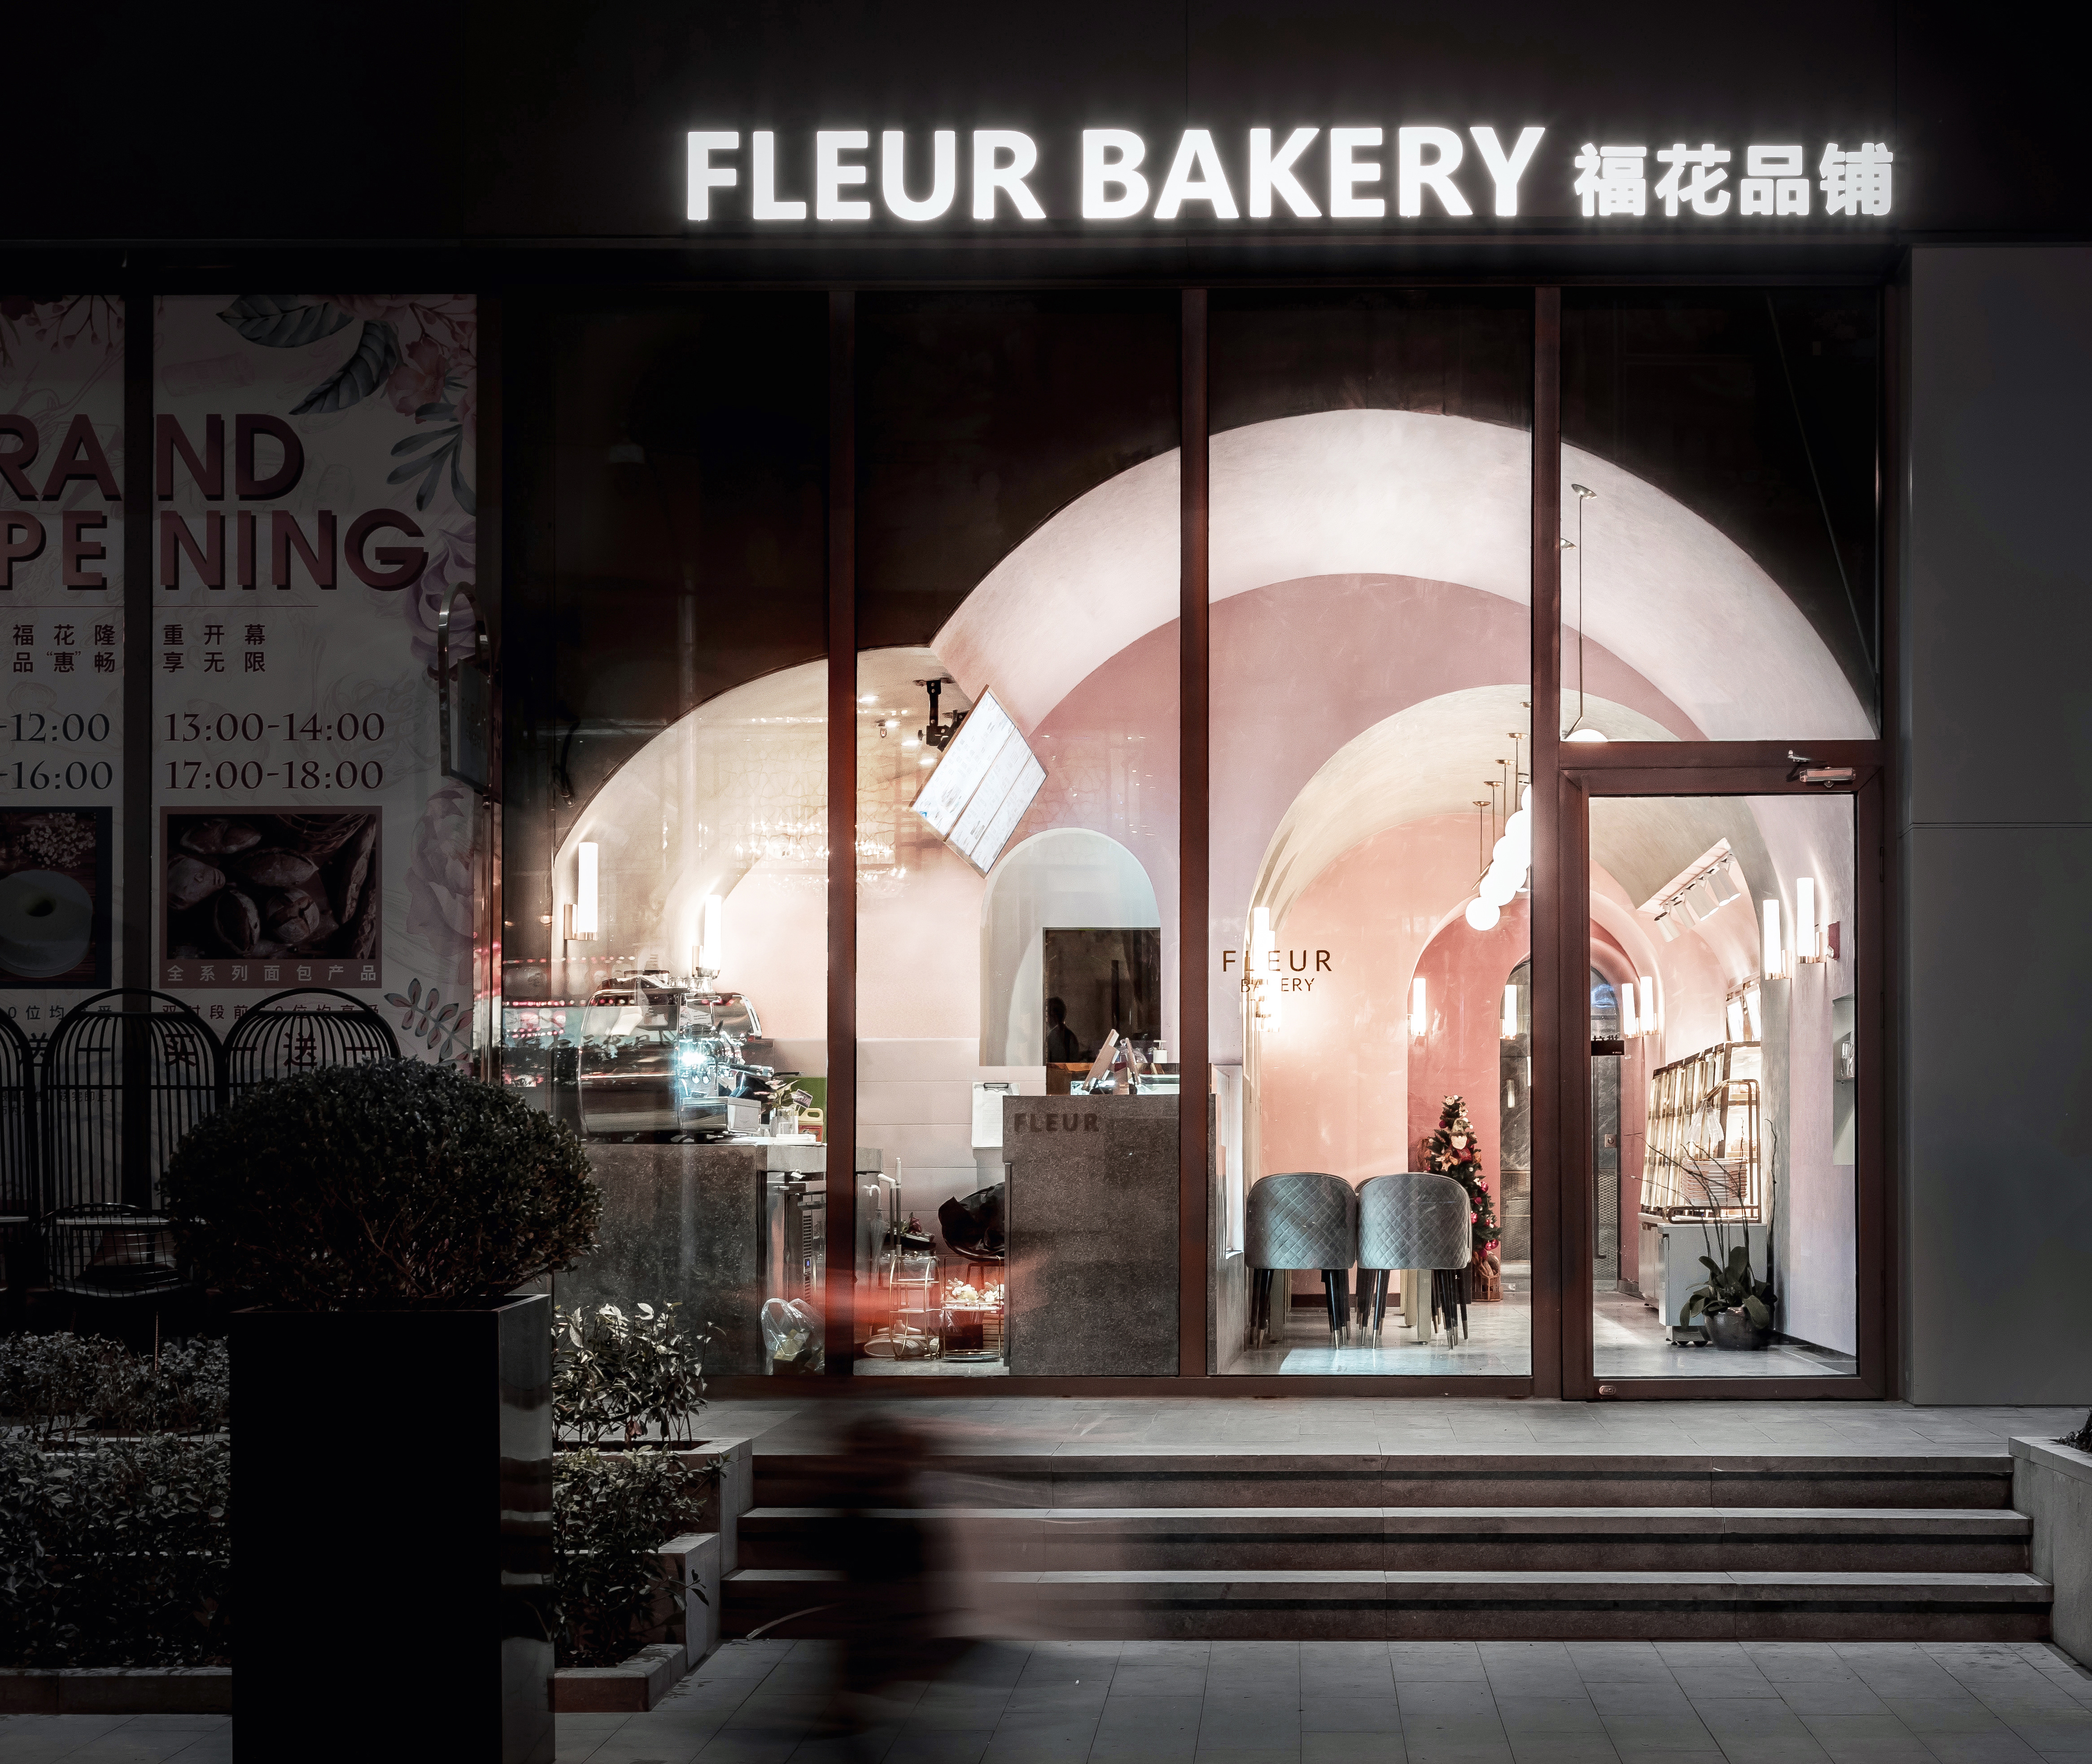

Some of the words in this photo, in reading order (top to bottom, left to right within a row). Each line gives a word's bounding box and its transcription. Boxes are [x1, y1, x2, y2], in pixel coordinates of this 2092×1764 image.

[687, 130, 1046, 221] FLEUR
[1081, 127, 1546, 219] BAKERY
[1572, 141, 1894, 217] 福花品铺
[164, 712, 384, 743] 13:00-14:00
[165, 759, 384, 790] 17:00-18:00
[167, 965, 376, 982] 全系列面包产品
[1241, 978, 1315, 992] BAERY
[1014, 1113, 1100, 1133] FLEUR
